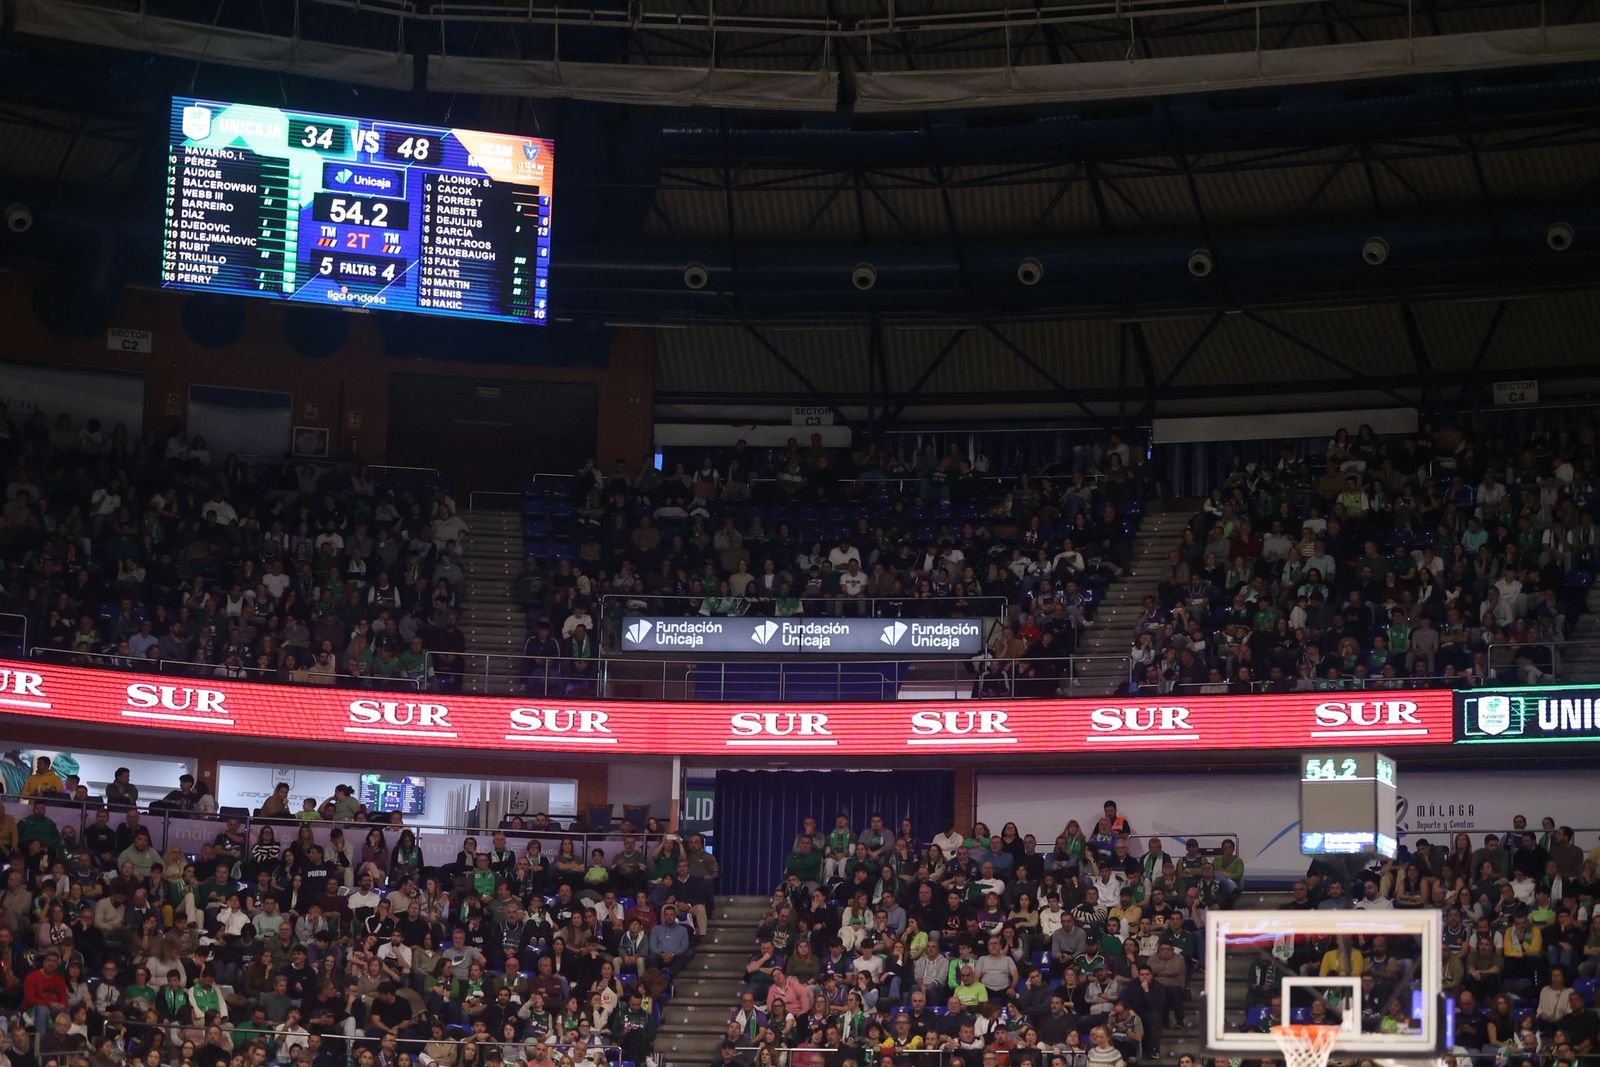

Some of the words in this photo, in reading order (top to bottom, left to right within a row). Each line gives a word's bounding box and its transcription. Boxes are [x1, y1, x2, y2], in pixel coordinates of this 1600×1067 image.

[301, 125, 334, 149] 34
[350, 129, 380, 154] VS
[397, 137, 430, 160] 48
[184, 154, 218, 168] PÉREZ
[183, 167, 222, 179] AUDIGE
[183, 178, 257, 193] BALCEROWSKI
[353, 175, 391, 188] Unicaja
[438, 174, 481, 187] ALONSO,
[483, 178, 492, 188] S.
[182, 188, 213, 199] WEBB
[437, 185, 472, 196] CACOK
[543, 197, 548, 205] 1
[437, 195, 483, 207] FORREST
[181, 198, 234, 212] BARREIRO
[181, 208, 204, 219] DÍAZ
[329, 198, 389, 228] 54.2
[437, 206, 478, 217] RAIESTE
[542, 217, 548, 226] 6
[168, 220, 178, 228] 14
[181, 220, 230, 232] DJEDOVIC
[320, 225, 337, 237] TM
[436, 216, 483, 228] DEJULIUS
[537, 227, 548, 237] 13
[436, 225, 473, 238] GARCÍA
[167, 230, 178, 239] 19
[180, 231, 257, 246] SULEJMANOVIC
[346, 232, 371, 249] 2T
[384, 232, 400, 245] TM
[166, 240, 177, 249] 21
[179, 241, 210, 252] RUBIT
[424, 246, 434, 255] 12
[435, 247, 496, 261] RADEBAUGH
[436, 236, 492, 250] SANT-ROOS
[541, 248, 547, 257] 6
[166, 251, 177, 260] 22
[178, 252, 227, 264] TRUJILLO
[423, 256, 433, 265] 13
[434, 257, 460, 268] FALK
[165, 262, 176, 270] 27
[178, 262, 219, 274] DUARTE
[319, 257, 334, 275] 5
[339, 262, 377, 276] FALTAS
[381, 263, 396, 281] 4
[164, 272, 176, 281] 55
[177, 273, 212, 284] PERRY
[421, 277, 432, 286] 30
[433, 278, 470, 290] MARTIN
[434, 268, 460, 278] CATE
[540, 279, 546, 288] 6
[421, 287, 432, 297] 31
[433, 288, 462, 299] ENNIS
[432, 299, 463, 310] NAKIC
[534, 310, 545, 319] 10
[112, 328, 148, 340] SECTOR
[121, 340, 138, 350] C2
[1497, 382, 1535, 391] SECTOR
[1508, 392, 1526, 402] C4
[805, 417, 821, 426] C3
[656, 620, 722, 634] Fundación
[782, 621, 850, 636] Fundación
[911, 622, 979, 637] Fundación
[656, 633, 704, 647] Unicaja
[782, 634, 831, 649] Unicaja
[911, 635, 960, 650] Unicaja
[126, 683, 229, 714] SUR
[349, 699, 452, 727] SUR
[1091, 706, 1194, 731] SUR
[1315, 701, 1422, 727] SUR
[509, 708, 612, 734] SUR
[730, 712, 832, 737] SUR
[911, 710, 1012, 736] SUR
[1305, 758, 1357, 779] 54.2
[1416, 802, 1475, 817] MÁLAGA
[1416, 820, 1441, 831] Deporte
[1443, 822, 1448, 831] y
[1449, 819, 1475, 830] Eventos
